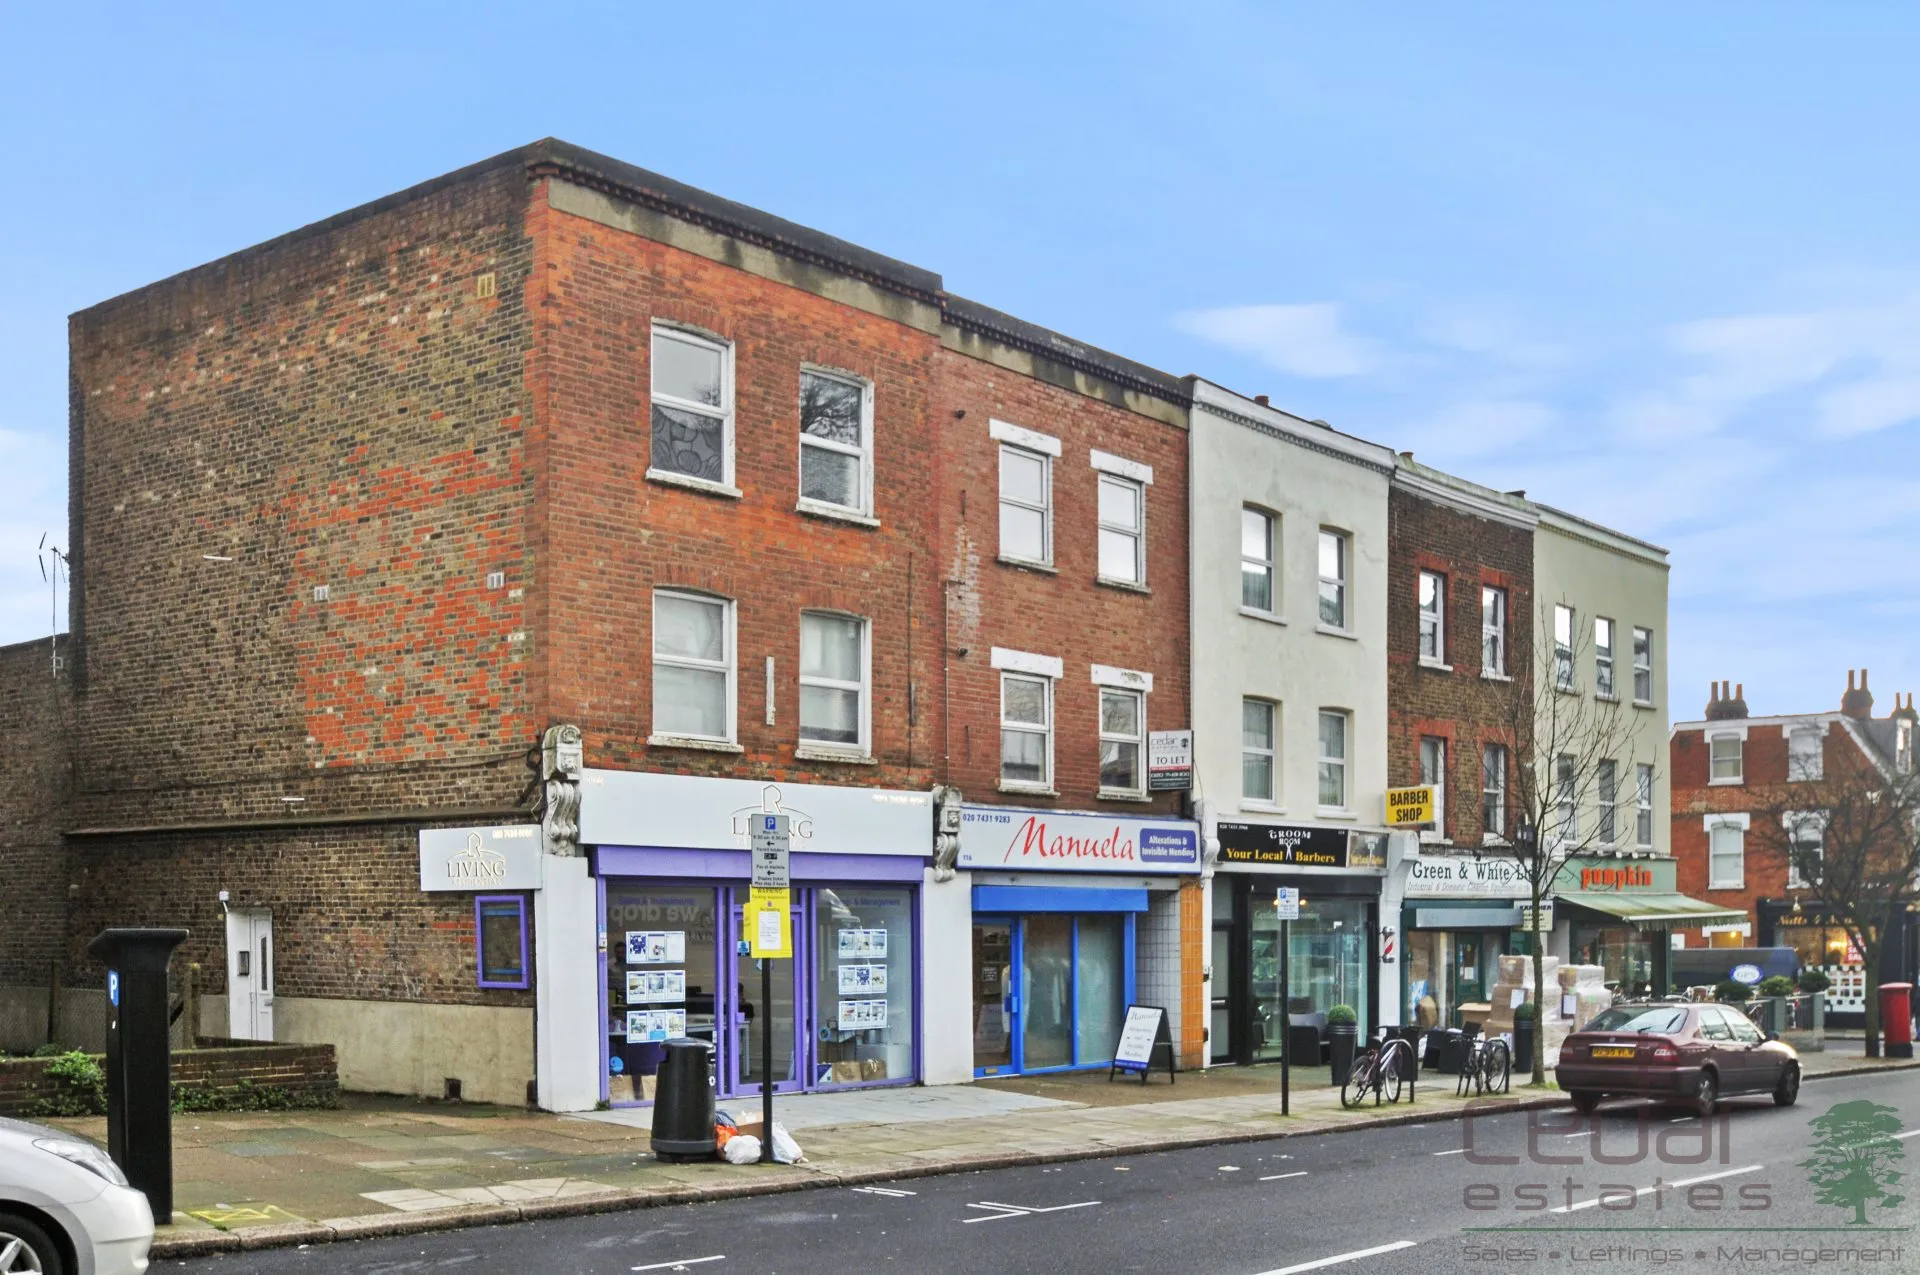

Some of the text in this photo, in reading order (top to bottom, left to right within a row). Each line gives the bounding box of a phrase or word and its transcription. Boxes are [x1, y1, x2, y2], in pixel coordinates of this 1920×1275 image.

[1156, 756, 1185, 765] TO LET
[1390, 790, 1428, 806] BARBER
[962, 813, 975, 821] 020
[977, 814, 992, 822] 7431
[1396, 807, 1422, 822] SHOP
[1003, 815, 1134, 863] Manuela
[1149, 835, 1187, 845] Alterations &
[1268, 829, 1311, 839] GROOM
[1142, 846, 1194, 858] Invisible Mending
[1226, 848, 1336, 863] Your Local Barbers
[447, 860, 505, 878] LIVING
[1412, 861, 1451, 879] Green
[1459, 861, 1468, 879] &
[1475, 863, 1510, 880] White
[1581, 864, 1653, 892] pumpkin
[110, 974, 118, 1000] P
